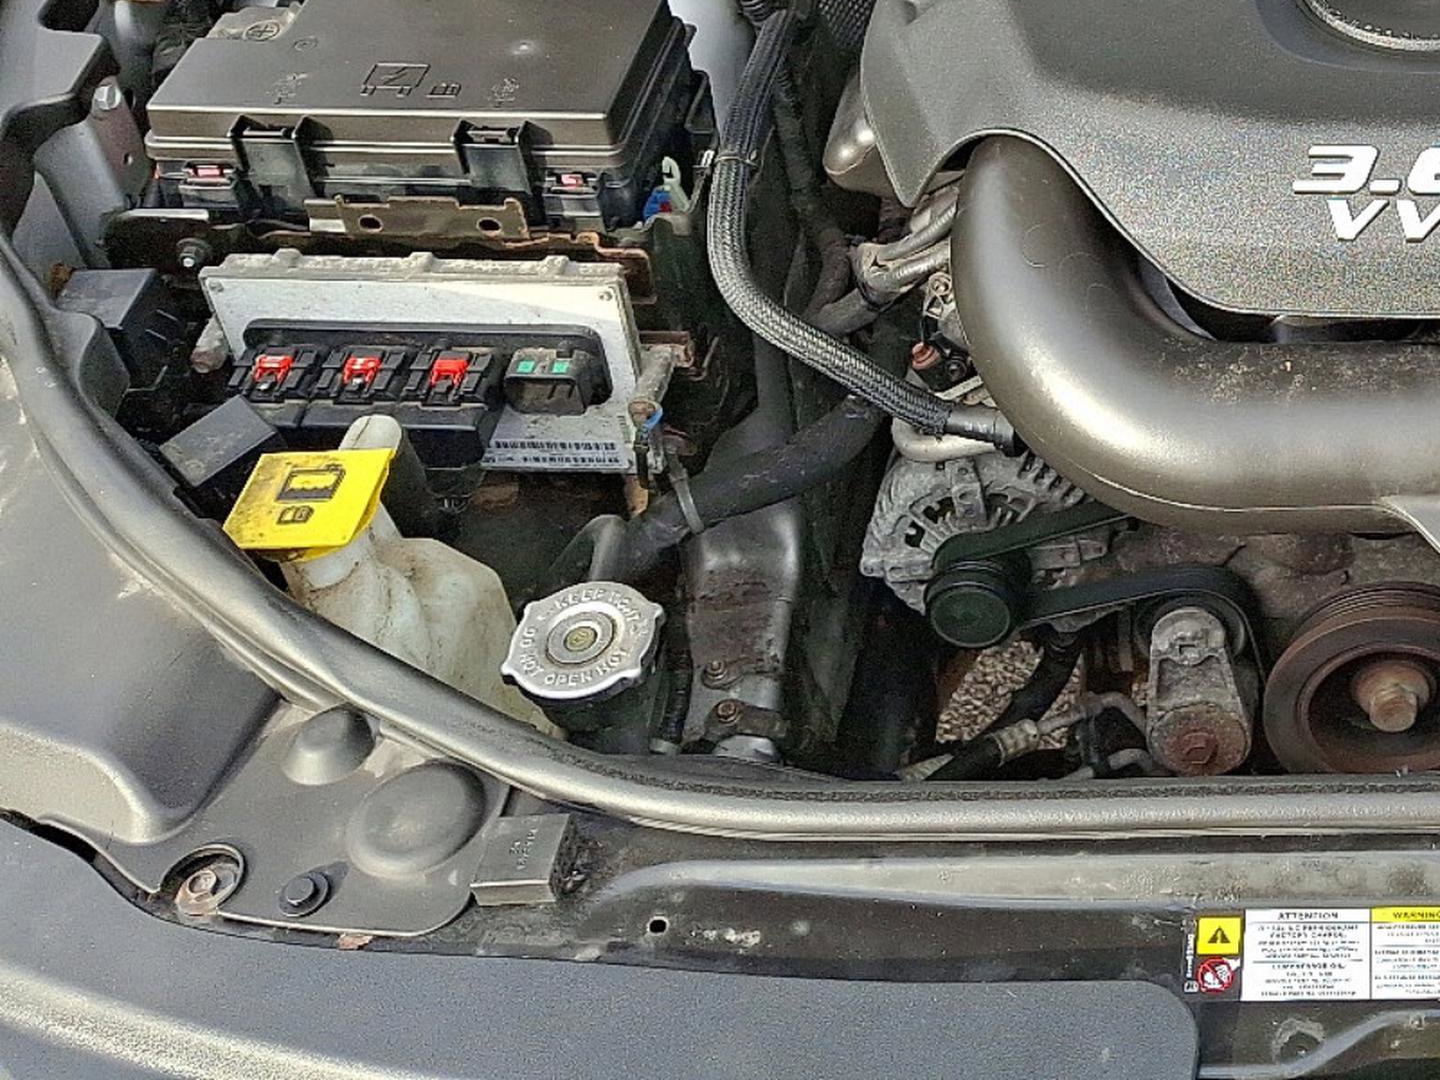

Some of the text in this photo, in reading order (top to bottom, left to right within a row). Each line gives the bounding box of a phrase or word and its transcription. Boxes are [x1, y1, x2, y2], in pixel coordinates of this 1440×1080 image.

[555, 588, 606, 609] KEEP
[544, 672, 593, 686] OPEN
[1278, 912, 1338, 920] ATTENTION
